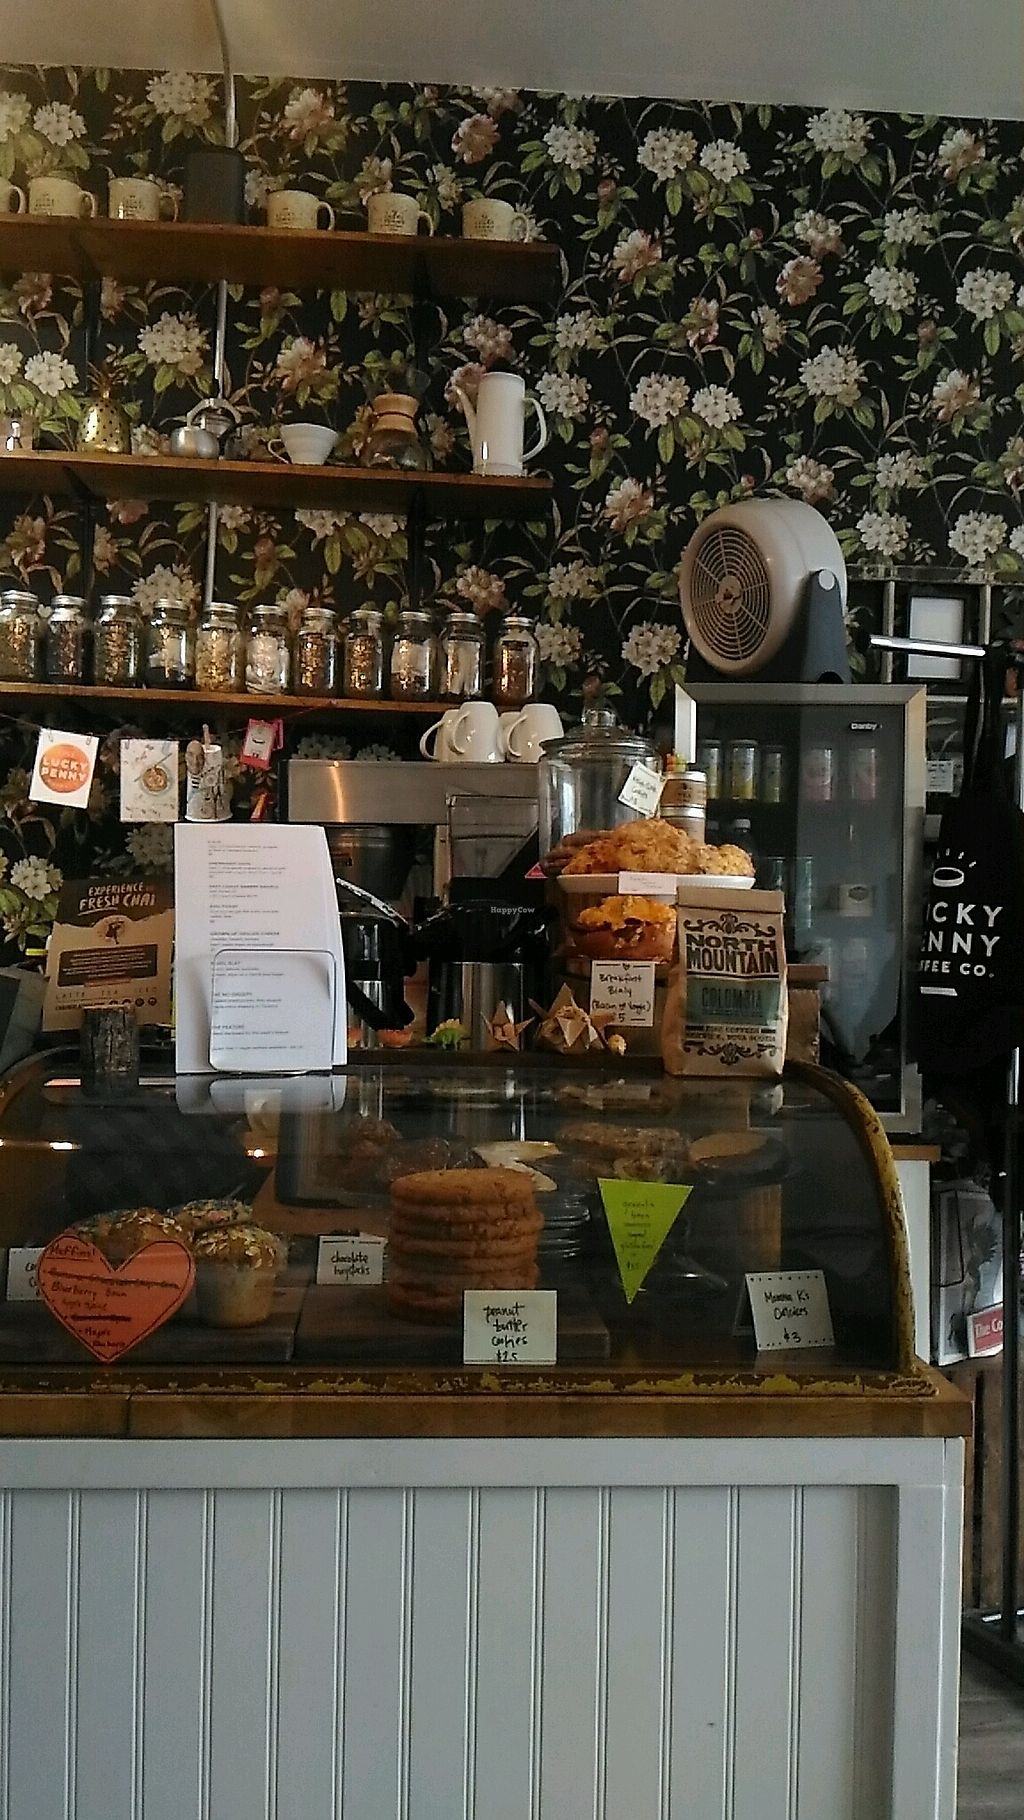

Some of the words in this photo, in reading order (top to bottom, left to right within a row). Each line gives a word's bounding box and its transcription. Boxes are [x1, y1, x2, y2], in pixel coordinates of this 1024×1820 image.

[851, 723, 877, 731] Danby
[42, 757, 88, 771] LUCKY
[41, 767, 87, 782] PENNY
[88, 882, 144, 897] EXPERIENCE
[79, 894, 120, 911] FRESH
[123, 893, 156, 908] CHAI
[926, 901, 1003, 928] CKY
[686, 933, 776, 952] NORTH
[687, 946, 777, 973] MOUNTAIN
[599, 973, 642, 983] Breakfast
[483, 1302, 526, 1324] peanut
